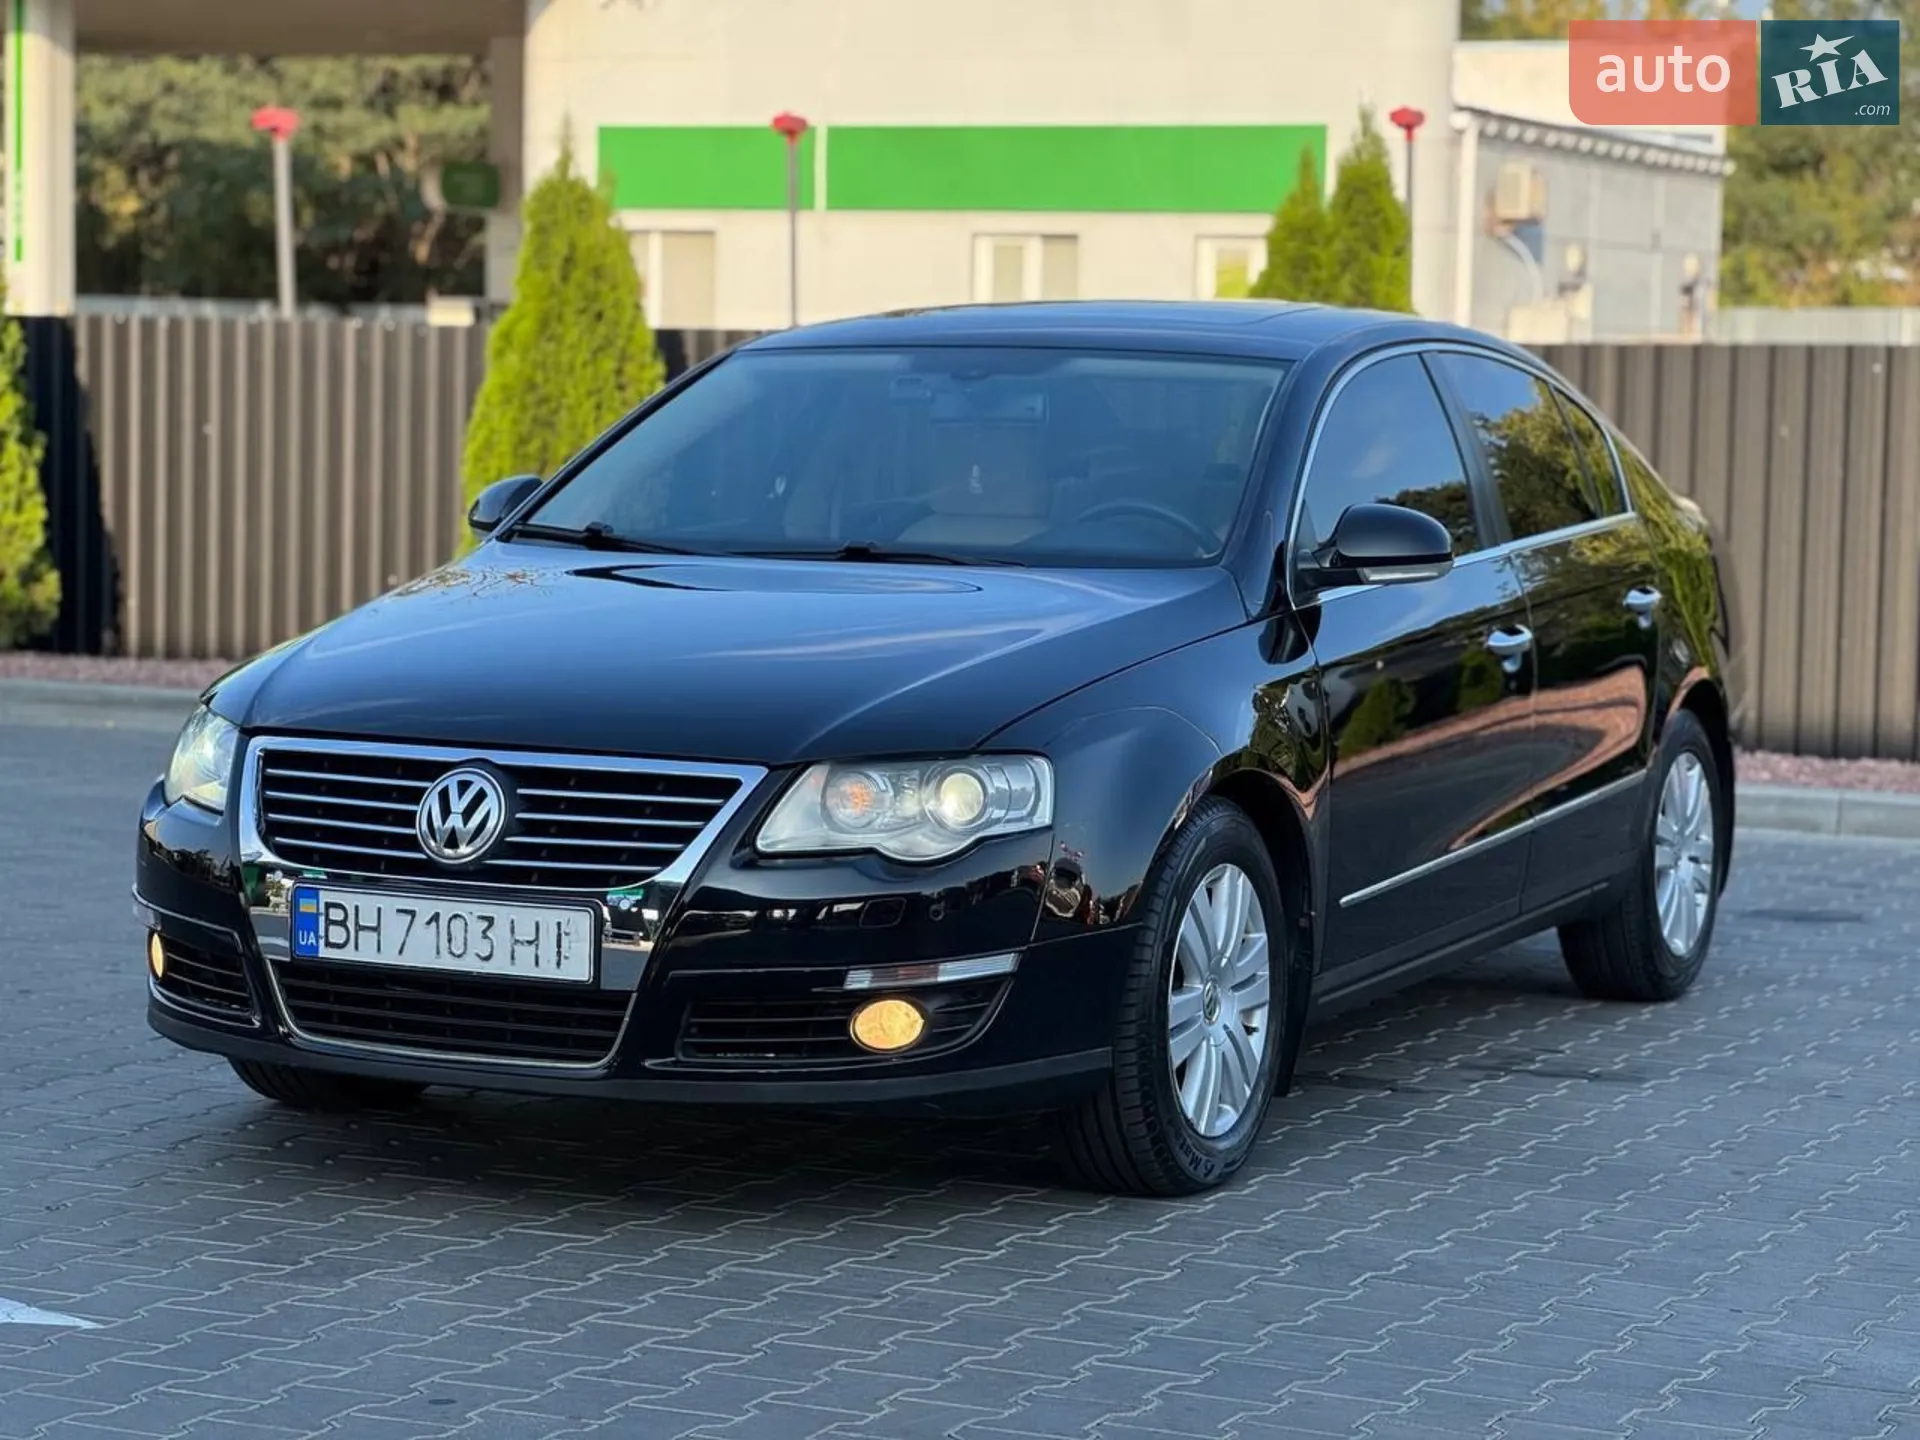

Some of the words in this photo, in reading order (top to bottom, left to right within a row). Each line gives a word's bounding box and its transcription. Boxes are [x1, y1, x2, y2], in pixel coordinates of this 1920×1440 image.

[298, 930, 316, 945] UA
[323, 901, 382, 954] BH
[395, 908, 495, 961] 7103
